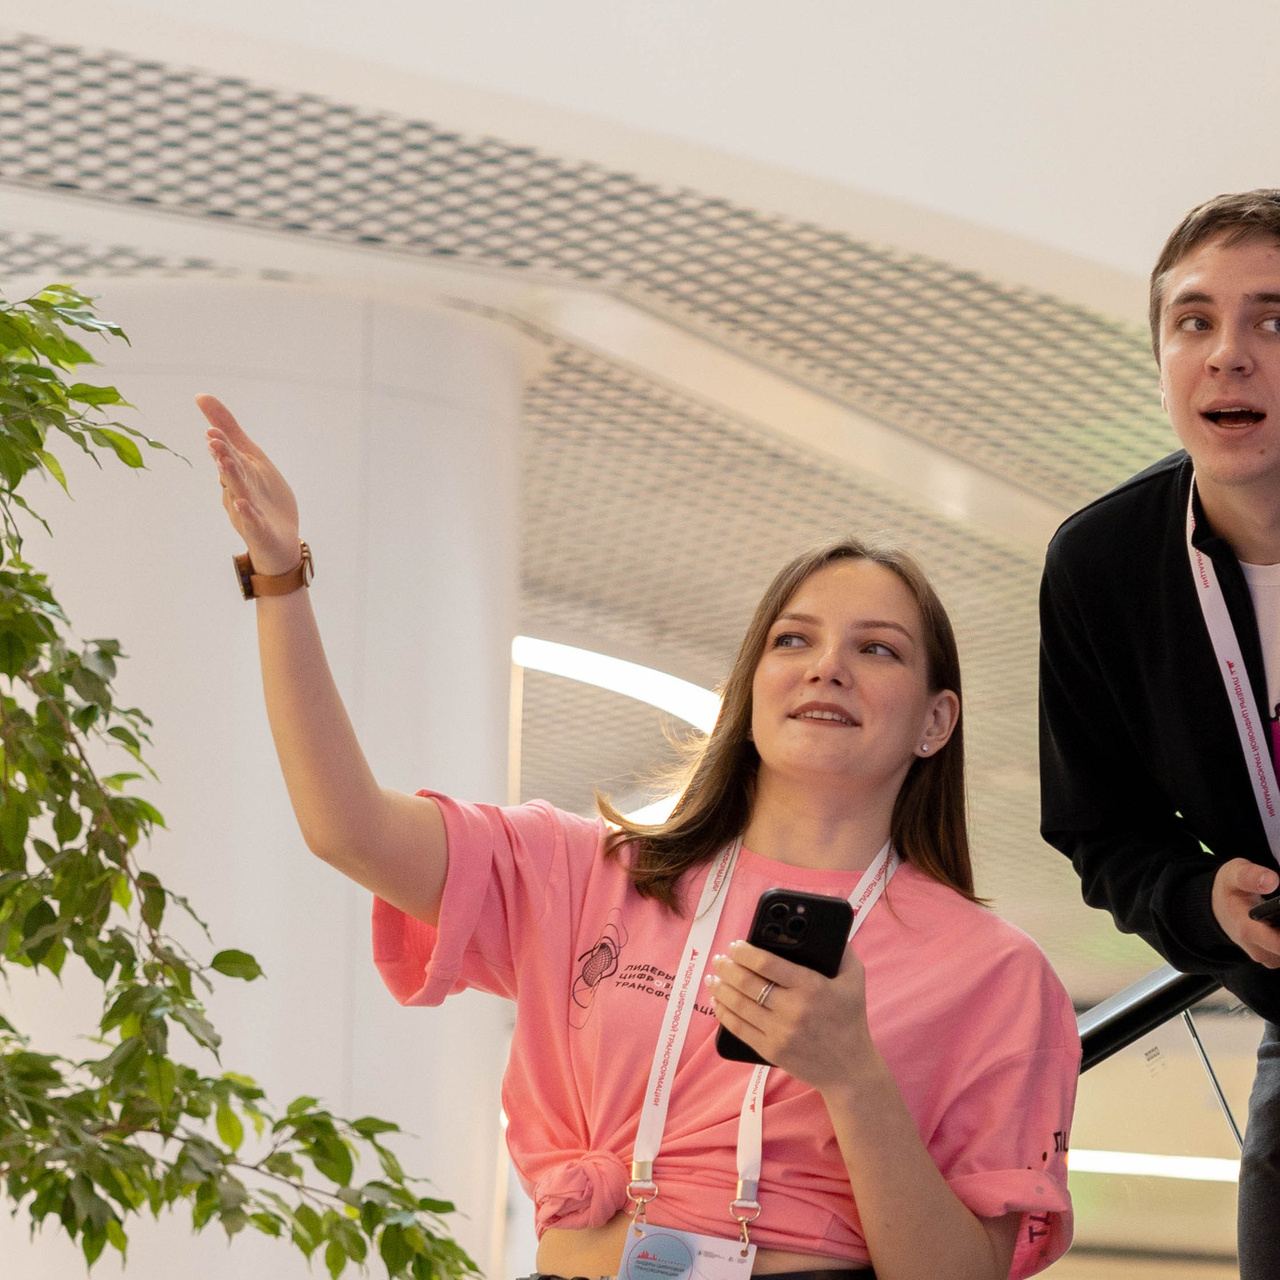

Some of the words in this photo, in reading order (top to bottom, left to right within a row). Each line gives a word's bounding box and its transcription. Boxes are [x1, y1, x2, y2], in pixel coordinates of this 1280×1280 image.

[1233, 676, 1246, 710] ЛИДЕРЫ
[1241, 709, 1259, 752] ЦИФРОВОЙ
[1254, 752, 1275, 818] ТРАНСФОРМАЦИИ
[624, 964, 676, 981] ЛИДЕРЫ
[682, 961, 695, 990] ЛИДЕРЫ
[670, 988, 688, 1032] ЦИФРОВОЙ
[653, 1033, 676, 1107] ТРАНСФОРМАЦИИ
